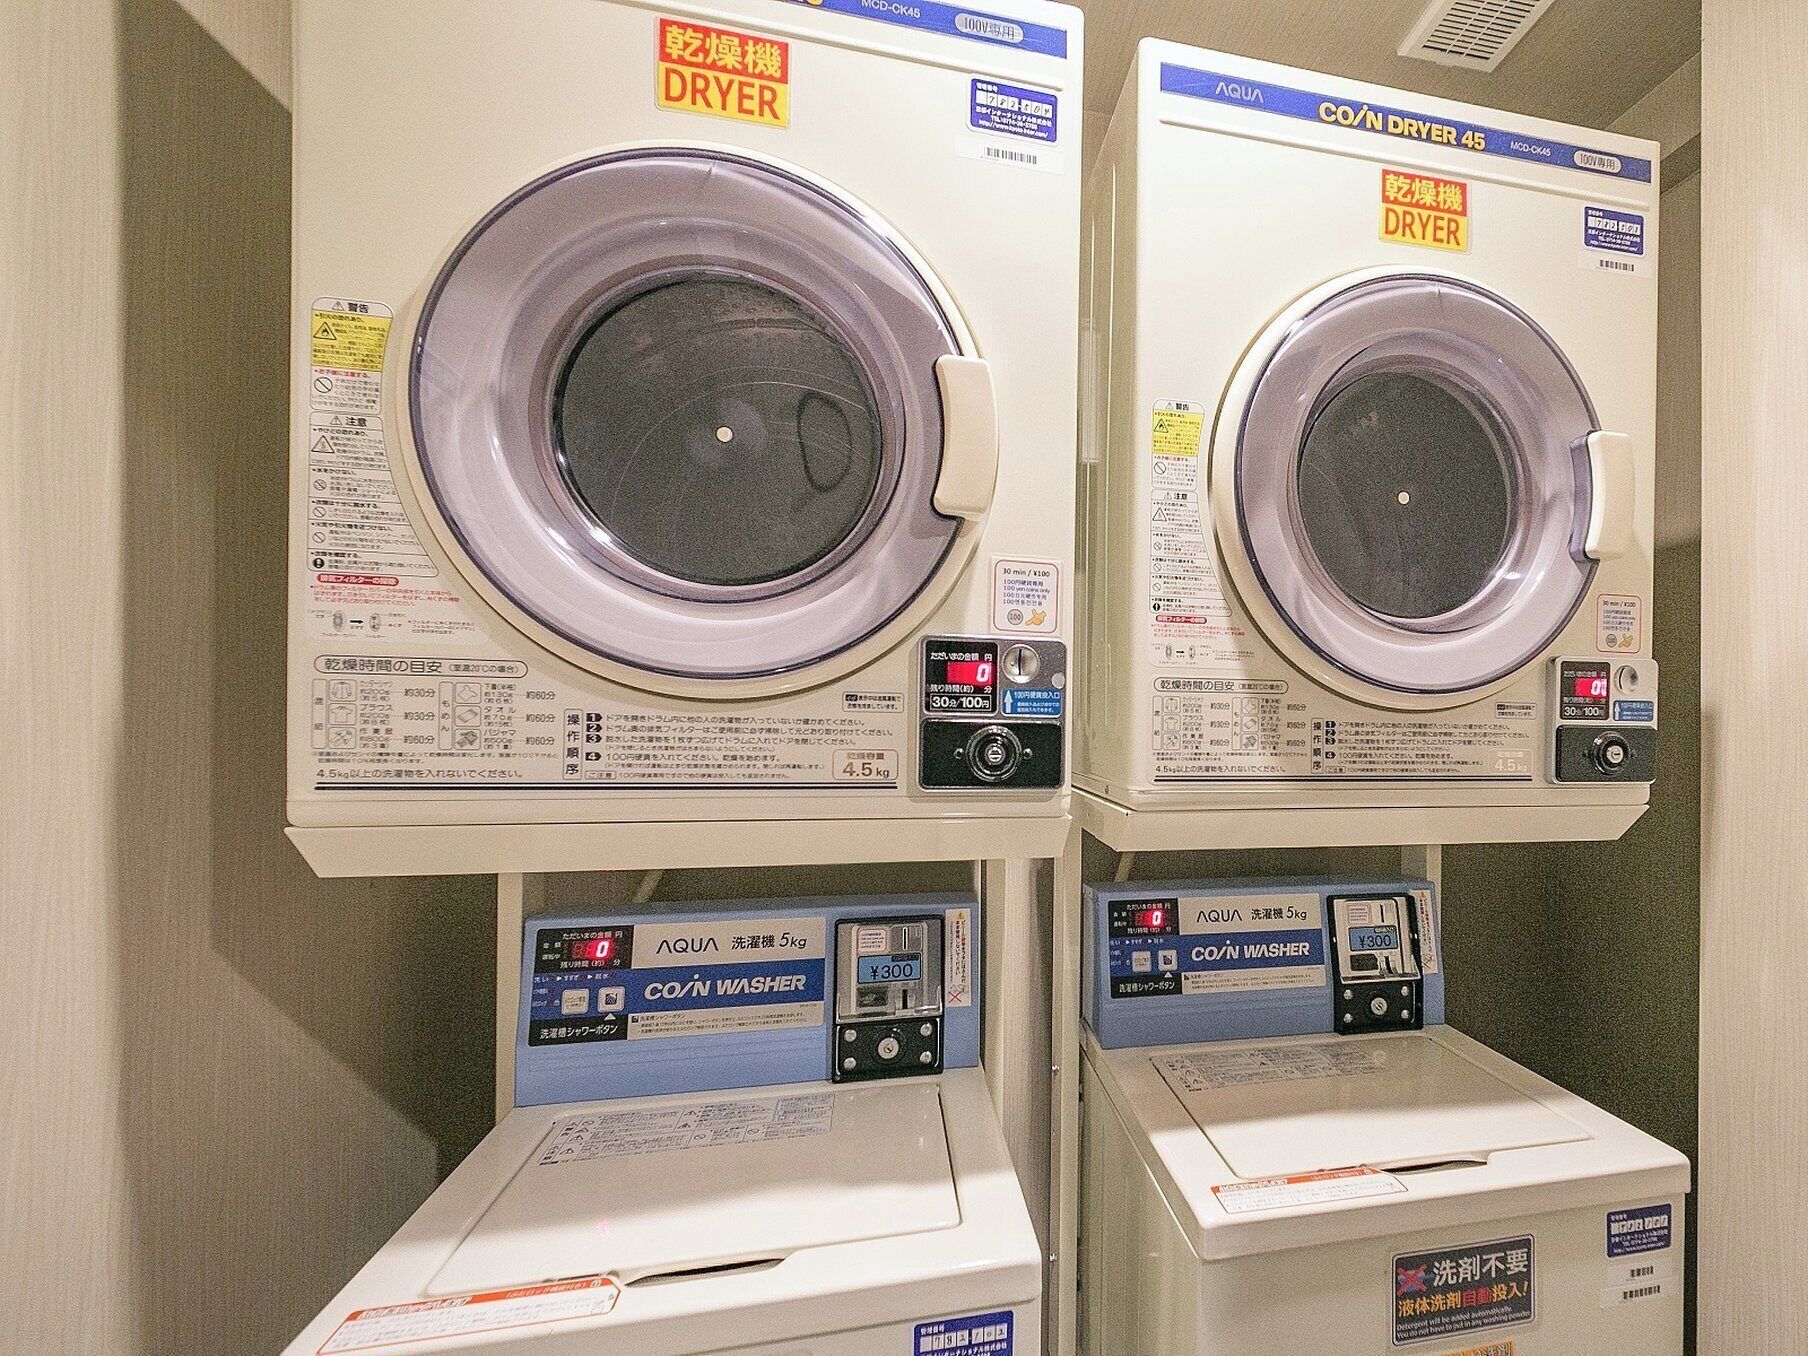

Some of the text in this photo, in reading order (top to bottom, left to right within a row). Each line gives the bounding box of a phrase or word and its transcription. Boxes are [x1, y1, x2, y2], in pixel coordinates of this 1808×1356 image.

[665, 24, 782, 78] 乾燥機
[664, 67, 780, 120] DRYER
[1215, 81, 1264, 103] AQUA
[1318, 101, 1487, 151] COIN DRYER 45
[1384, 172, 1464, 211] 乾燥機
[1384, 207, 1461, 248] DRYER
[348, 302, 368, 313] 警告
[346, 416, 367, 427] 注意
[324, 657, 443, 674] 乾燥時間の目安
[984, 653, 993, 661] 円
[976, 664, 990, 682] 0
[983, 685, 992, 693] 分
[1160, 680, 1235, 691] 乾燥時間の目安
[932, 696, 989, 708] 30分/100円
[566, 713, 580, 775] 操作順序
[1313, 721, 1322, 770] 操作順序
[842, 762, 890, 778] 4.5 kg
[1495, 758, 1528, 773] 4.5 kg
[1152, 910, 1162, 926] 0
[1196, 909, 1243, 923] AQUA
[1251, 906, 1307, 920] 洗濯機 5kg
[562, 931, 623, 940] ただいまの金額 円
[731, 932, 807, 950] 洗濯機 5kg
[1359, 934, 1392, 948] ¥300
[595, 940, 610, 958] 0
[656, 937, 719, 954] AQUA
[1191, 940, 1310, 961] COIN WASHER
[613, 958, 621, 967] 分
[870, 963, 913, 980] ¥300
[644, 973, 806, 1000] COIN WASHER
[1433, 1248, 1528, 1287] 洗剤不要
